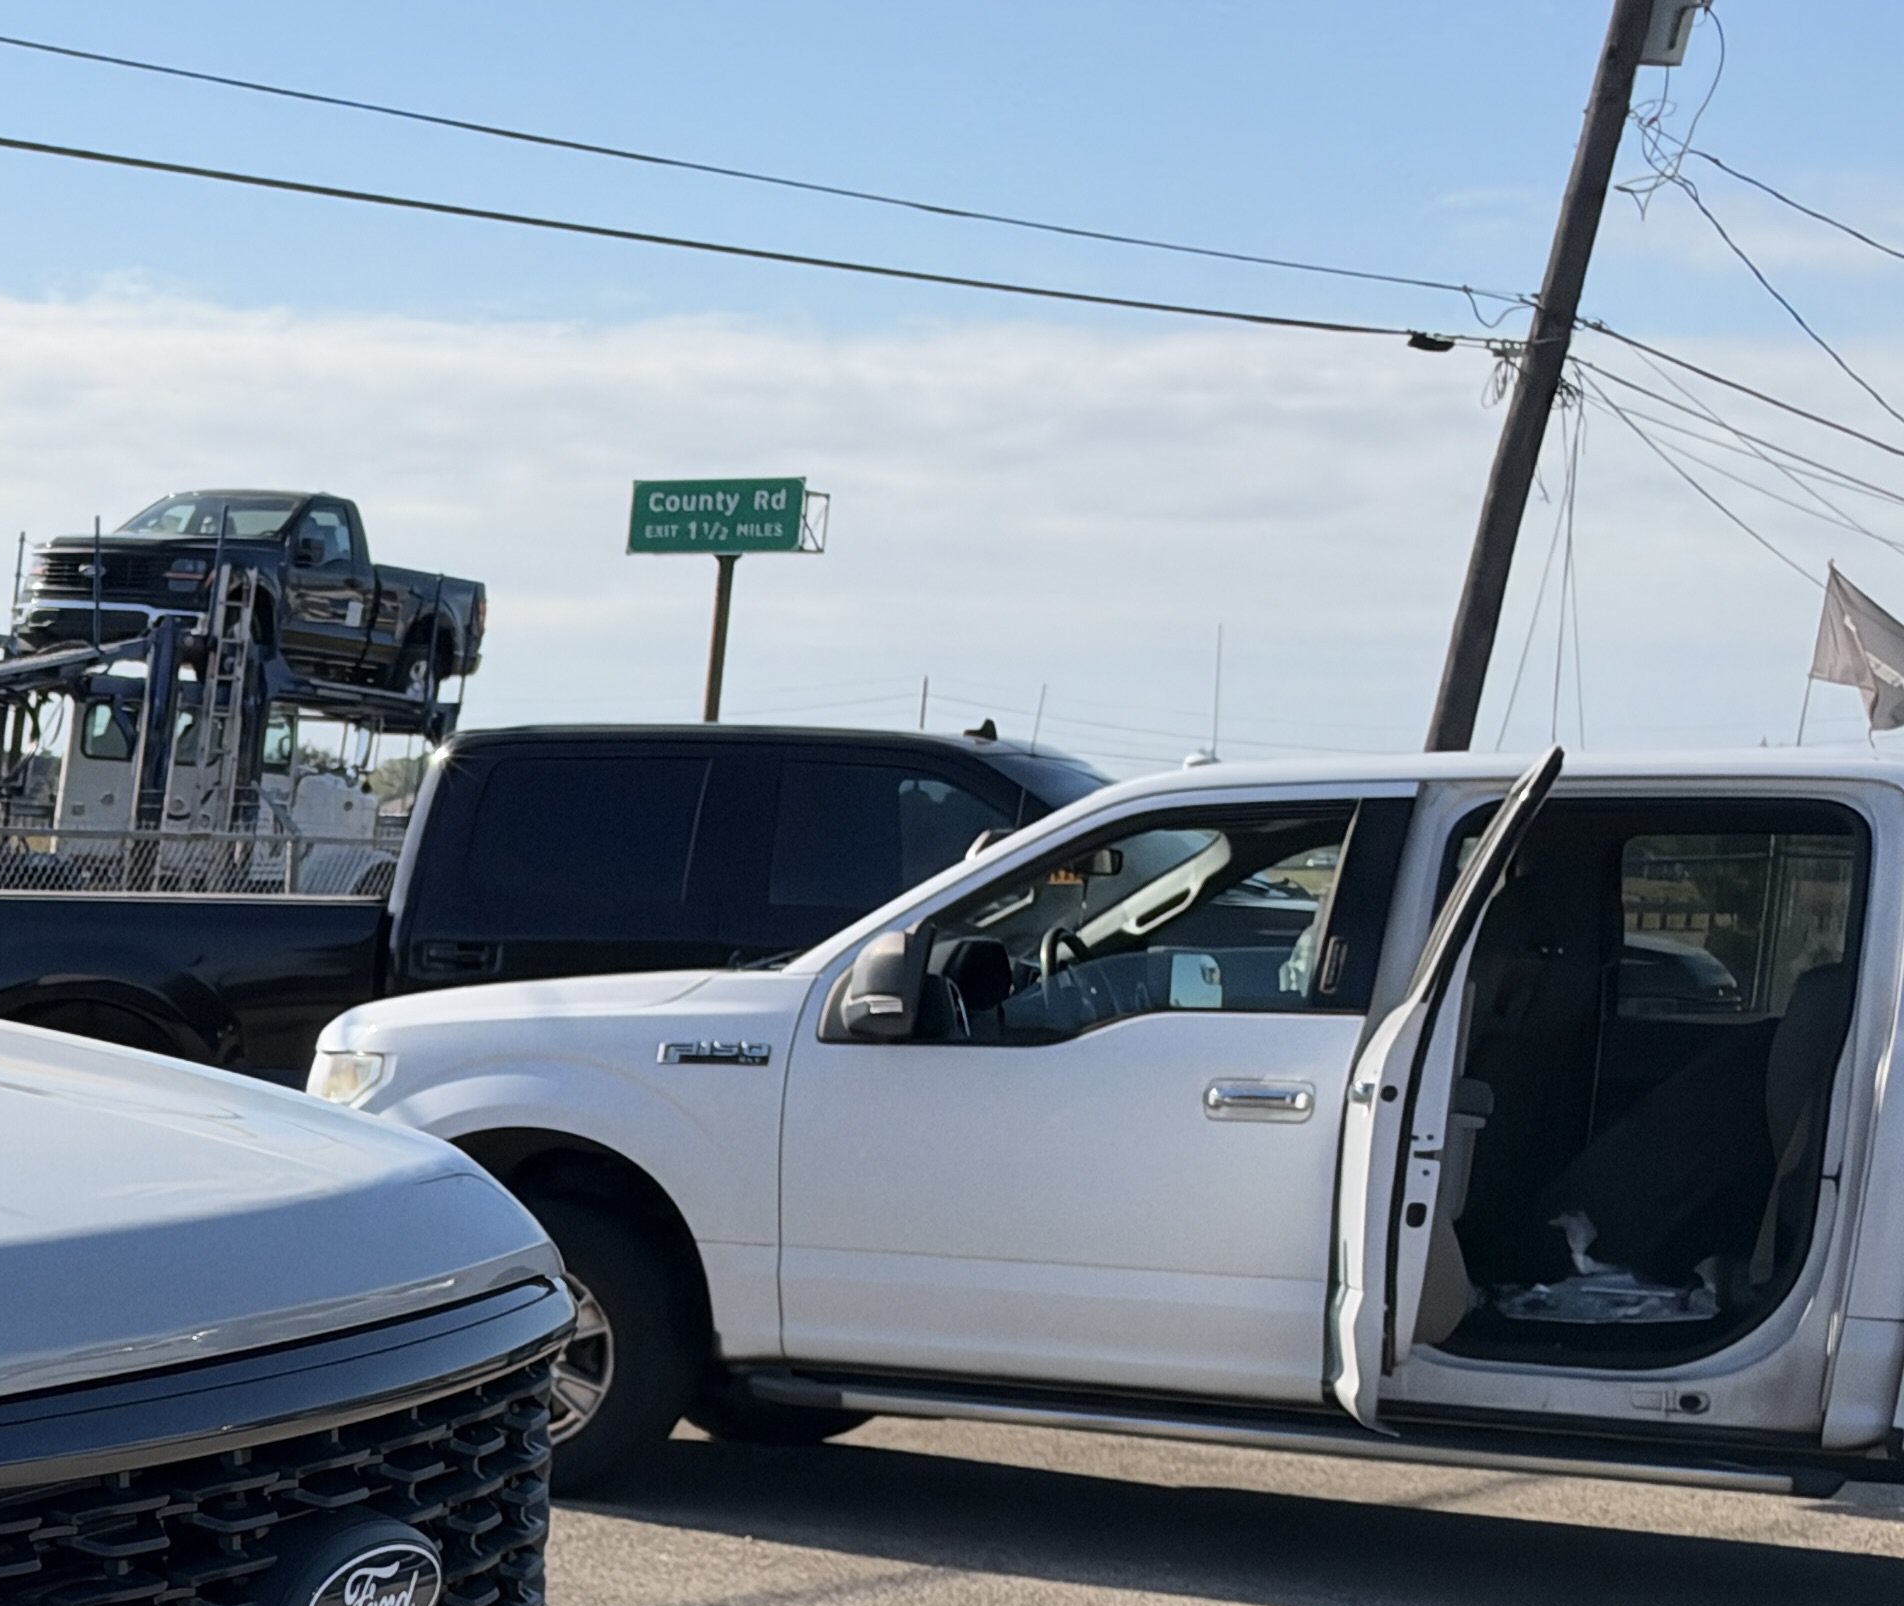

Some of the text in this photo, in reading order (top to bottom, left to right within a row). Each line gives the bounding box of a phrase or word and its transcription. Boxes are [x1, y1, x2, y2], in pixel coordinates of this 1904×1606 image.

[648, 488, 788, 517] County Rd
[644, 523, 680, 539] EXIT
[736, 522, 785, 538] MILES
